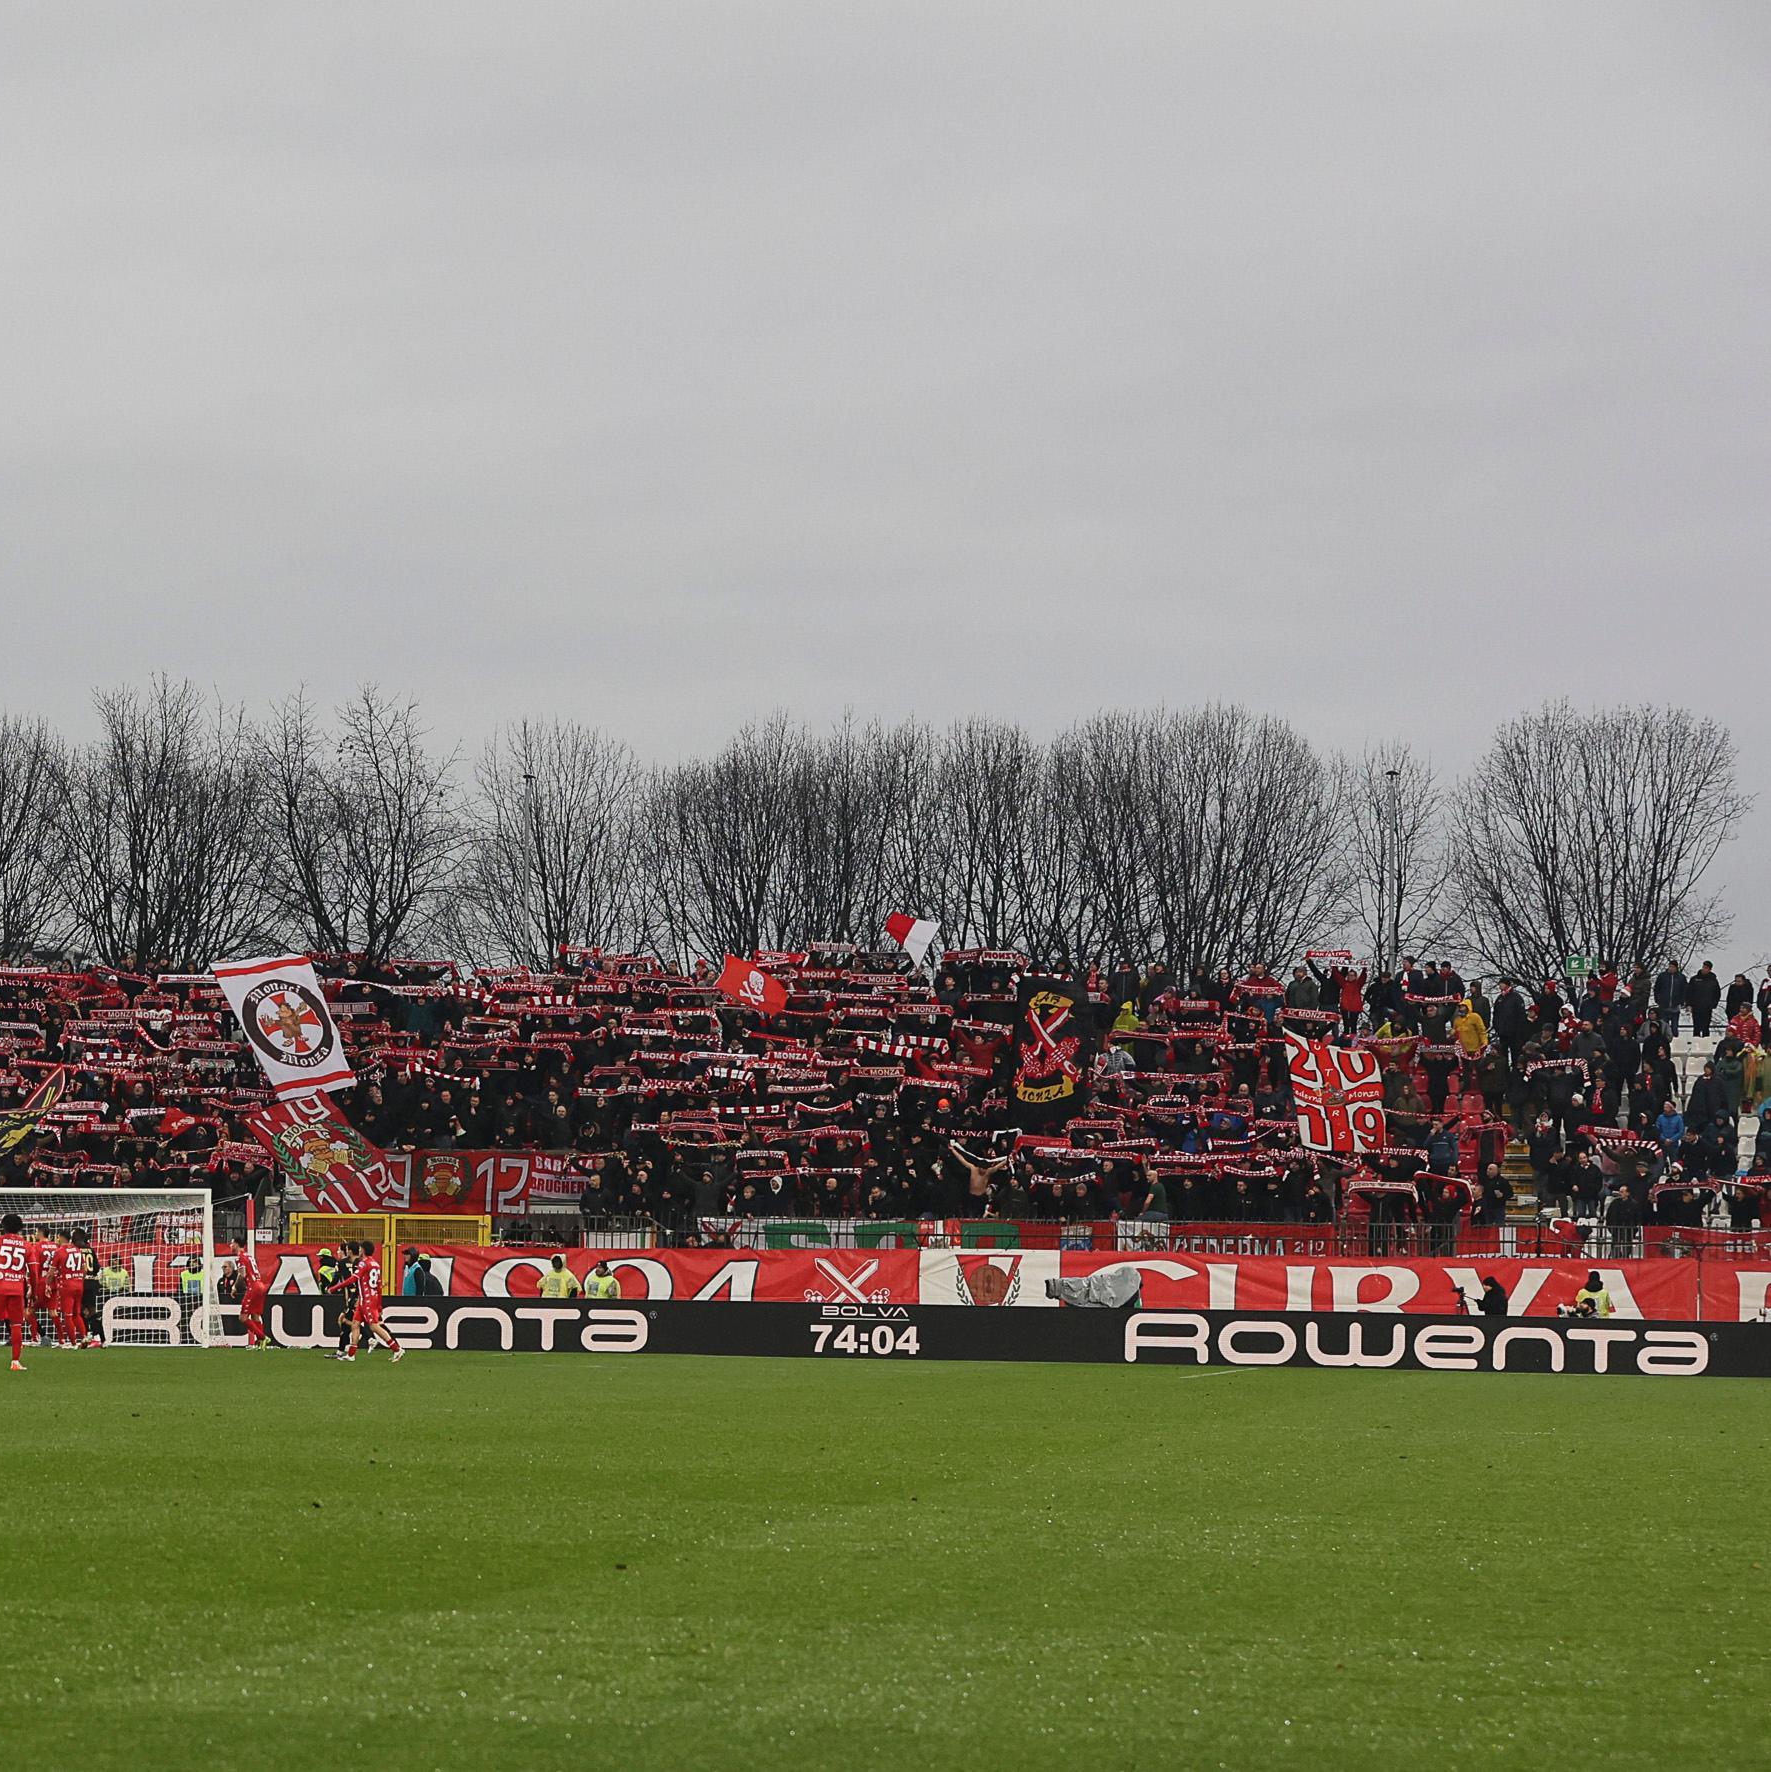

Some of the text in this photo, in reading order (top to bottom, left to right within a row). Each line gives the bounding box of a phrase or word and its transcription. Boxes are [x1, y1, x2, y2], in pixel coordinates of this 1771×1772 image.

[802, 970, 837, 979] MONZA
[870, 976, 897, 984] MONZA
[578, 984, 614, 993] MONZA
[248, 983, 301, 1004] Monaci
[849, 1008, 884, 1017] MONZA
[913, 1006, 941, 1014] MONZA
[1287, 1010, 1327, 1019] AC MONZA
[175, 1013, 209, 1021] MONZA
[198, 1041, 226, 1050] MONZA
[281, 1046, 329, 1068] Monza
[641, 1052, 676, 1061] MONZA
[773, 1051, 808, 1061] MONZA
[816, 1057, 850, 1066] MONZA
[870, 1068, 901, 1077] MONZA
[236, 1087, 268, 1099] Monaci
[1348, 1089, 1380, 1100] Monza
[1382, 1147, 1413, 1156] DAVIDE
[65, 1252, 82, 1272] 47
[821, 1305, 910, 1318] BOLVA
[809, 1323, 920, 1356] 74:04
